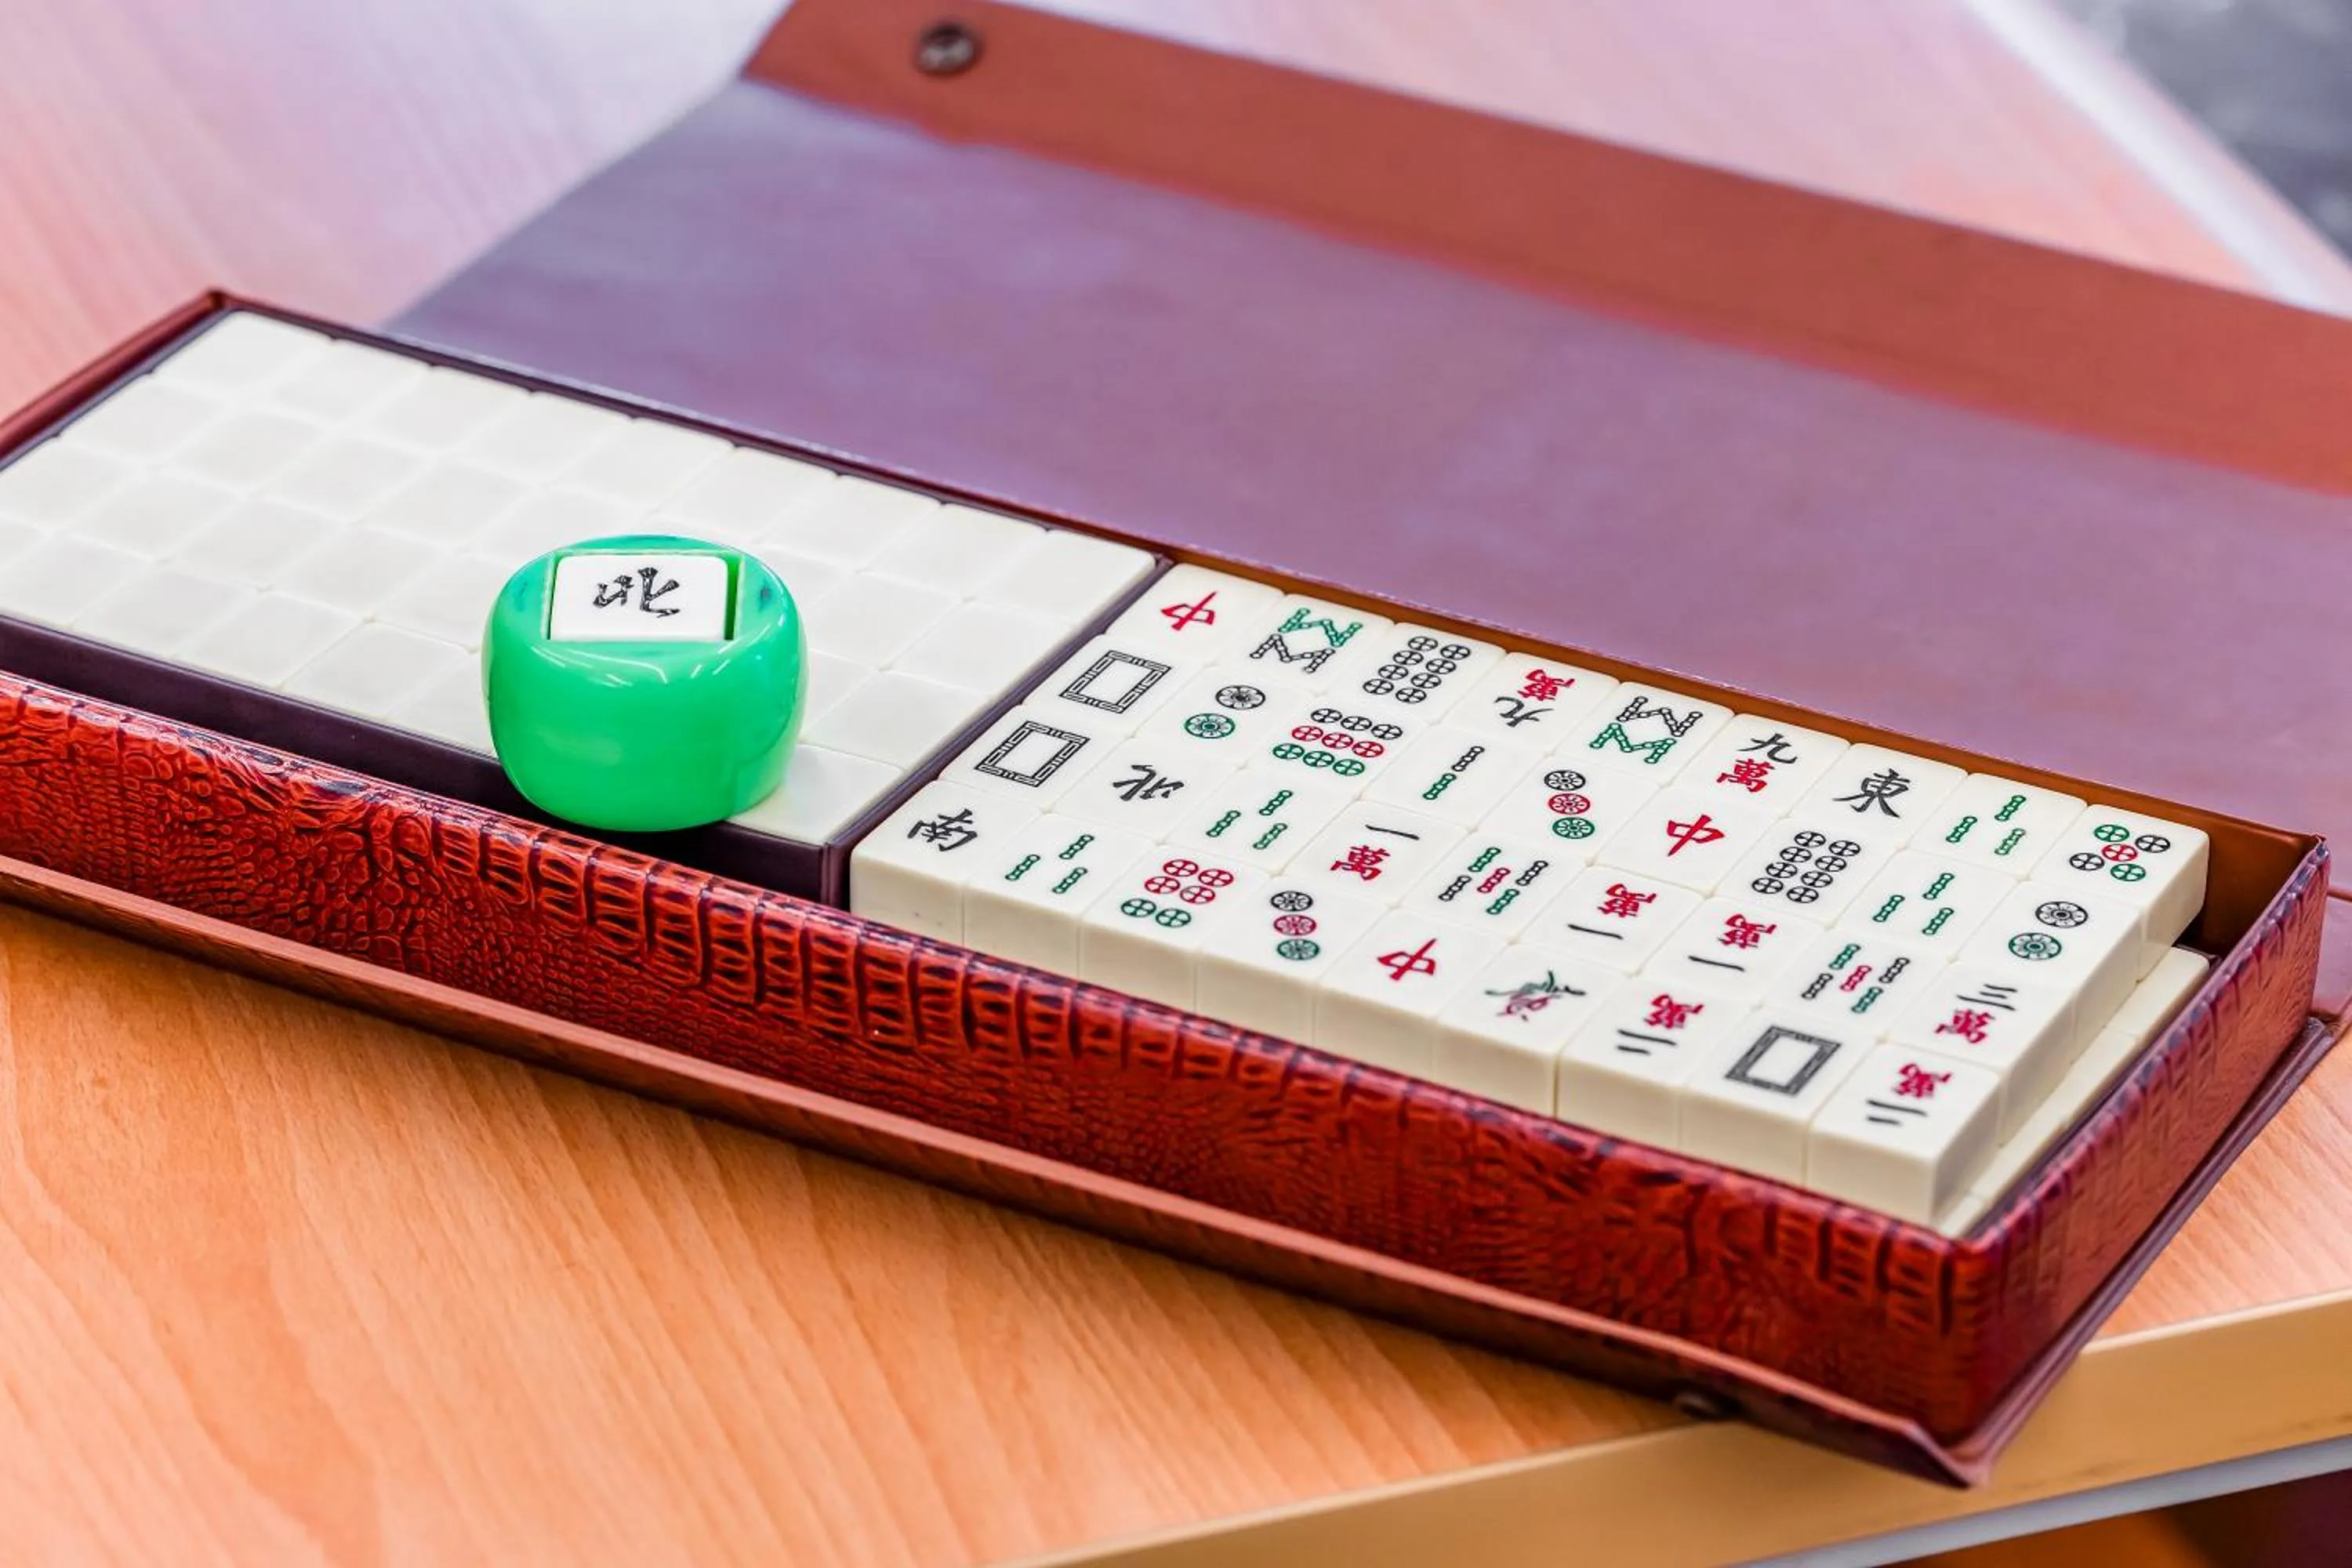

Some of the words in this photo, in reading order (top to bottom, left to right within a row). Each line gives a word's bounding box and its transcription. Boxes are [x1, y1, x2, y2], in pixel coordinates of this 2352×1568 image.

[592, 566, 681, 619] 北
[1160, 590, 1218, 632] 中
[1111, 764, 1185, 803] 北
[1835, 768, 1910, 818] 東
[907, 808, 979, 852] 南
[1665, 813, 1726, 858] 中
[1376, 937, 1438, 982] 中
